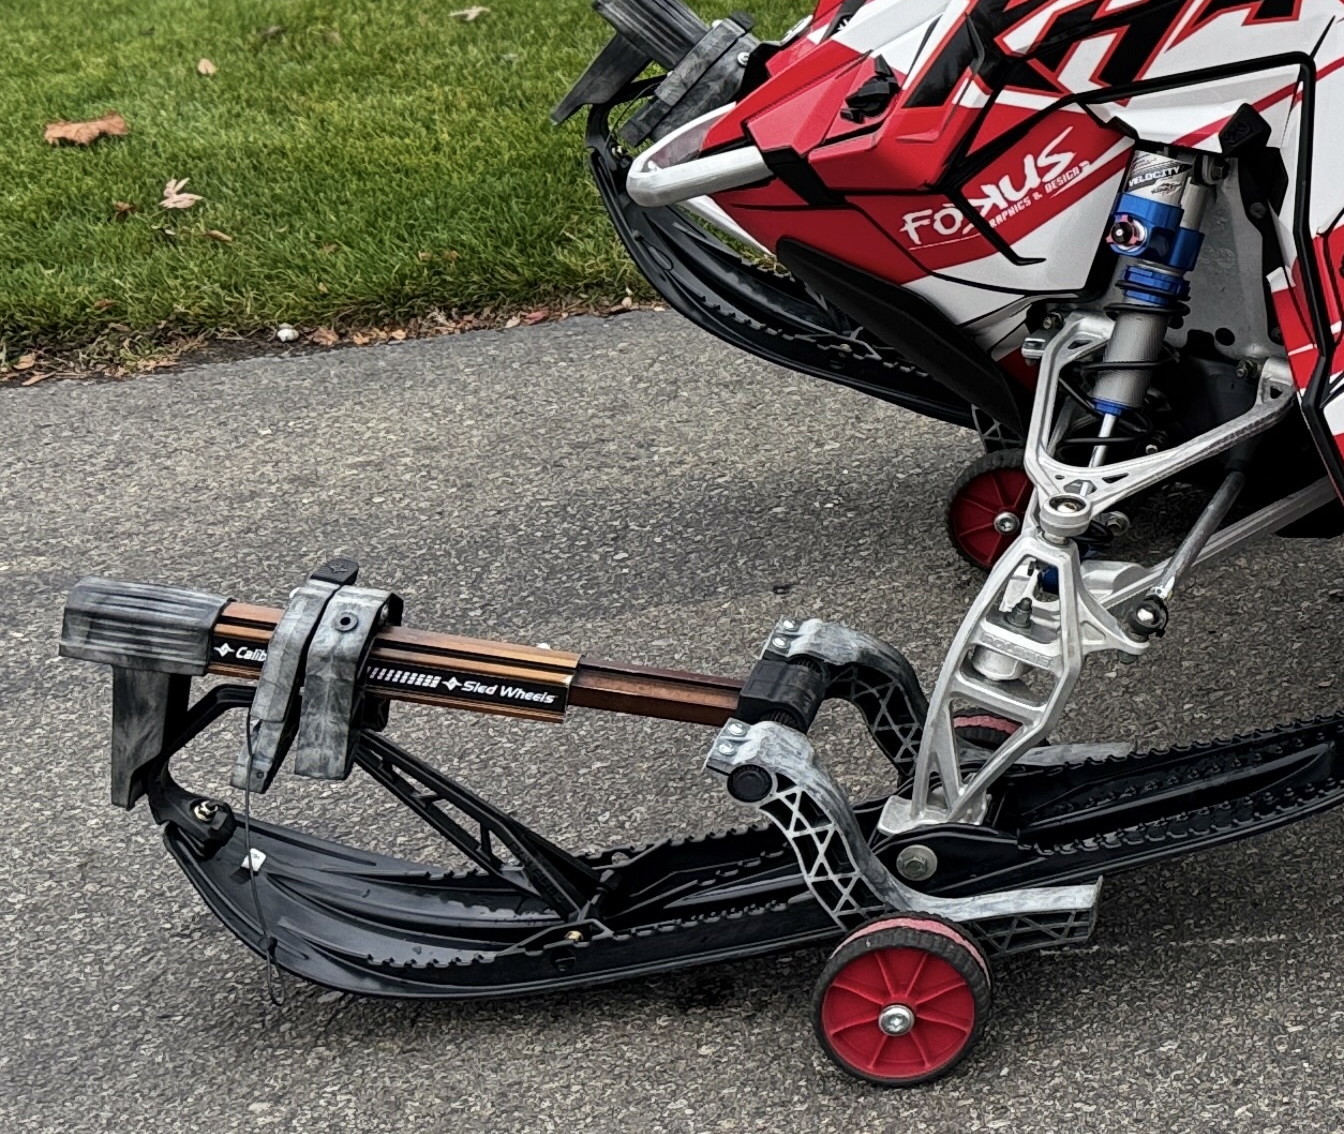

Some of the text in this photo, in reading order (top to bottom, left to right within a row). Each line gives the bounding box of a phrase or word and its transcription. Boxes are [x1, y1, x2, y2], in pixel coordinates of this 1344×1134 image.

[1129, 166, 1180, 187] VELOCITY
[990, 195, 1032, 228] RAPHICS
[1033, 191, 1043, 201] &
[235, 646, 558, 704] Calib Sled Wheels
